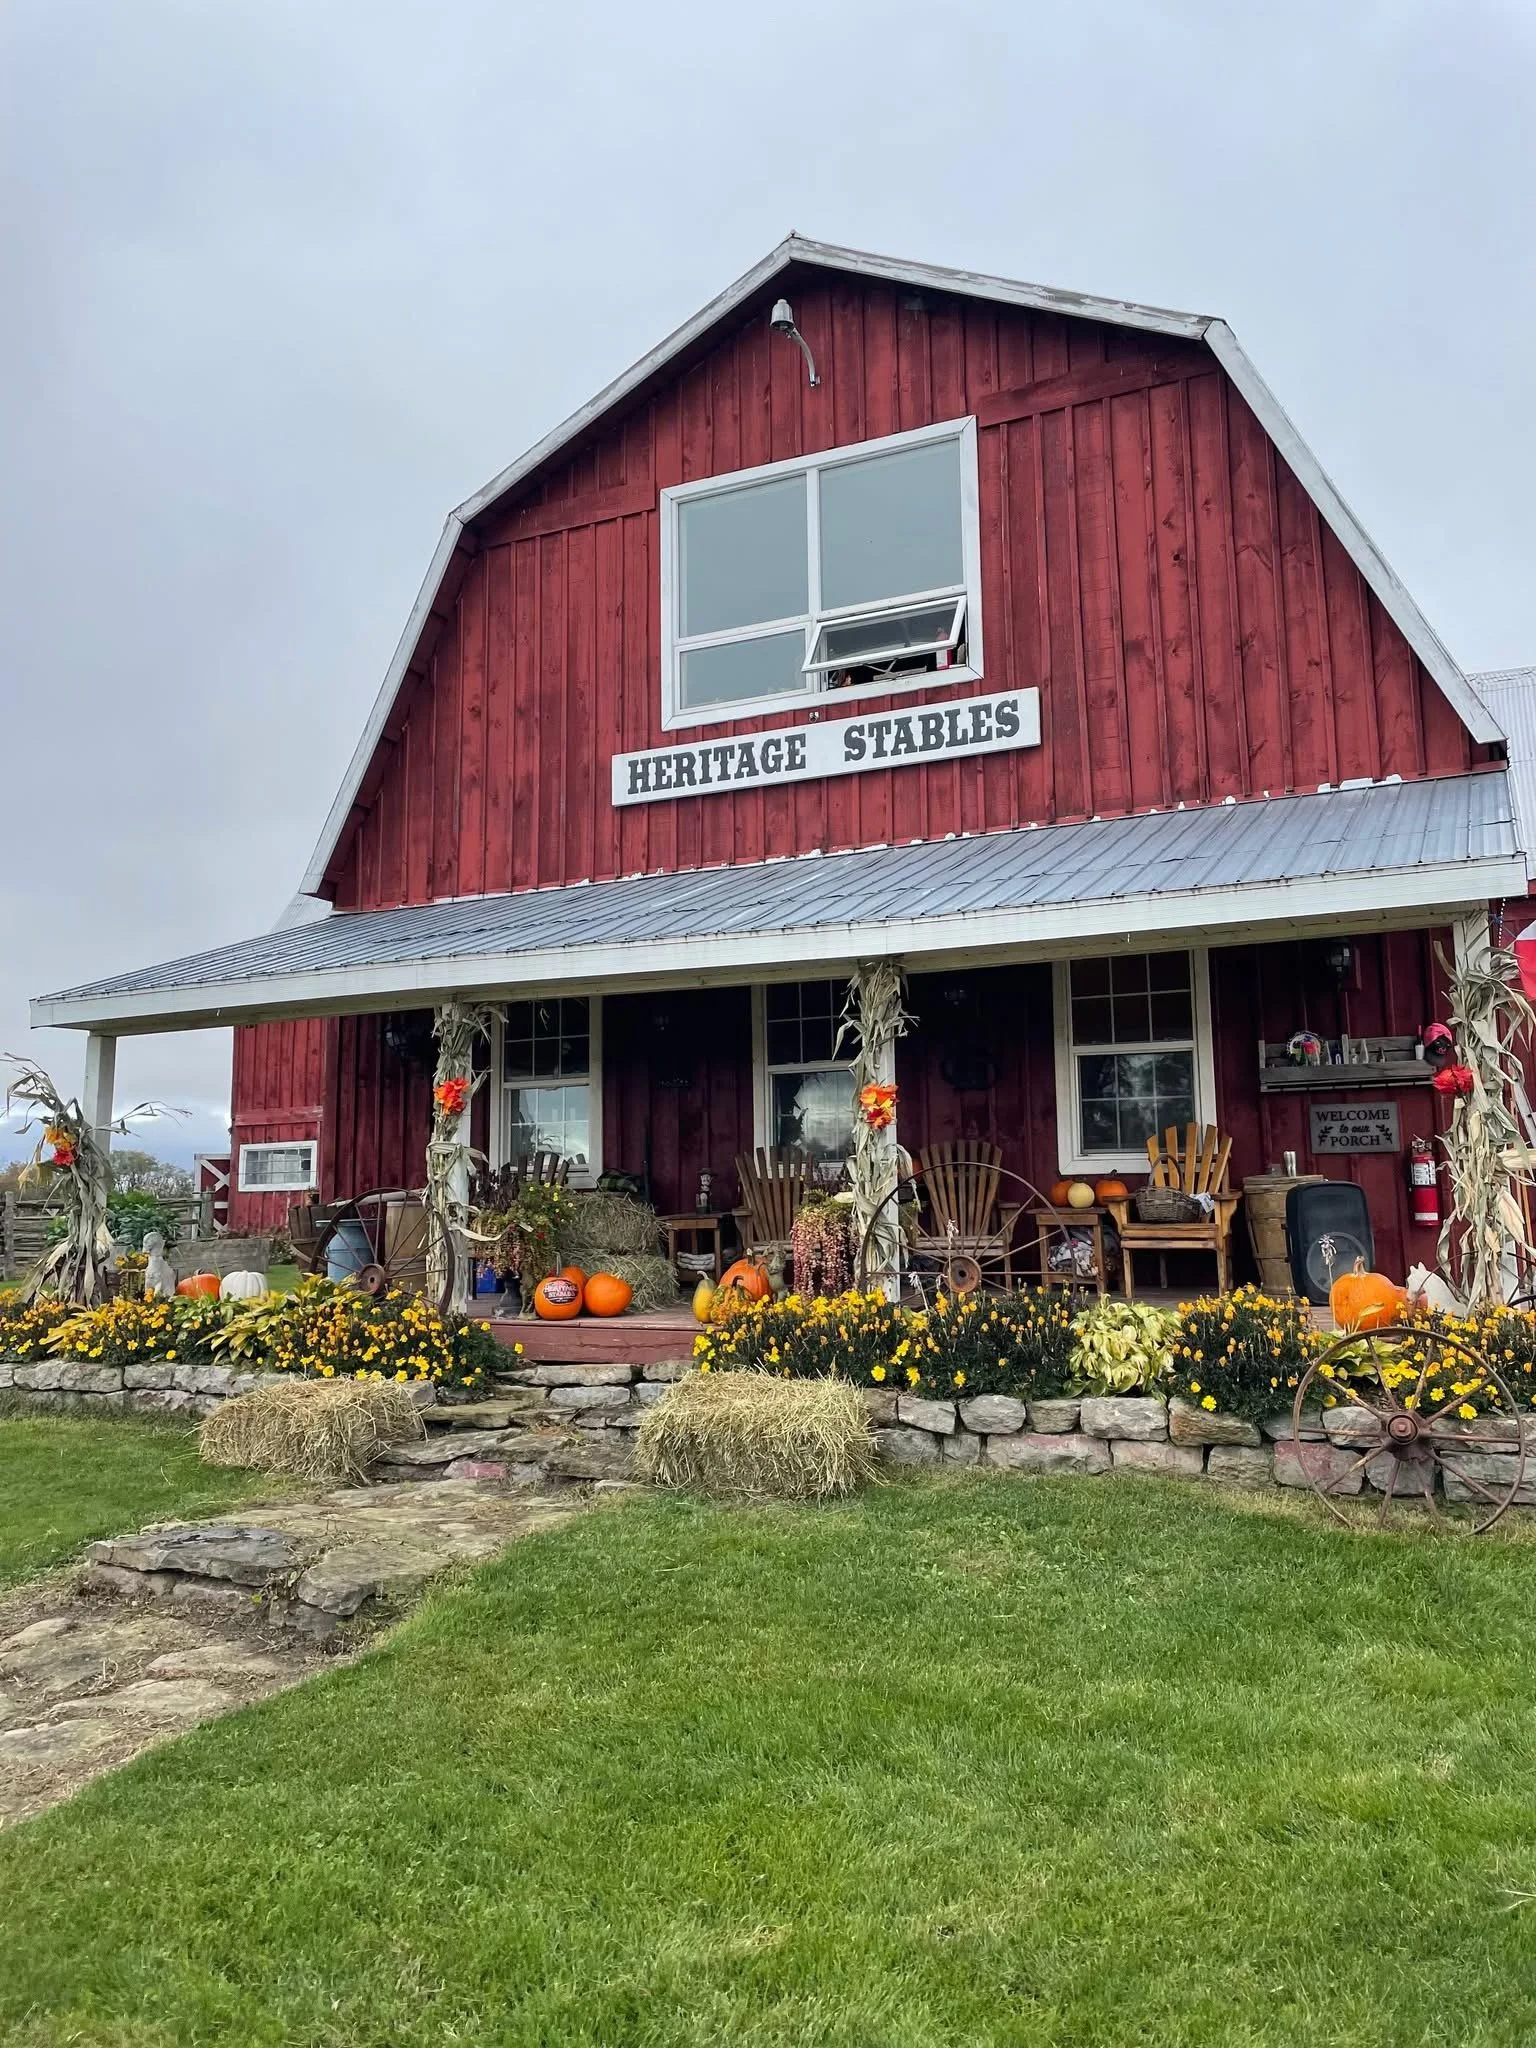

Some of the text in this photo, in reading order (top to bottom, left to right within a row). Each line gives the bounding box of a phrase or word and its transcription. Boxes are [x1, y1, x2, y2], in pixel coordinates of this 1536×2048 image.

[627, 699, 1020, 795] HERITAGE STABLES
[1315, 1109, 1390, 1122] WELCOME
[1339, 1123, 1371, 1133] to our
[1330, 1135, 1381, 1147] PORCH
